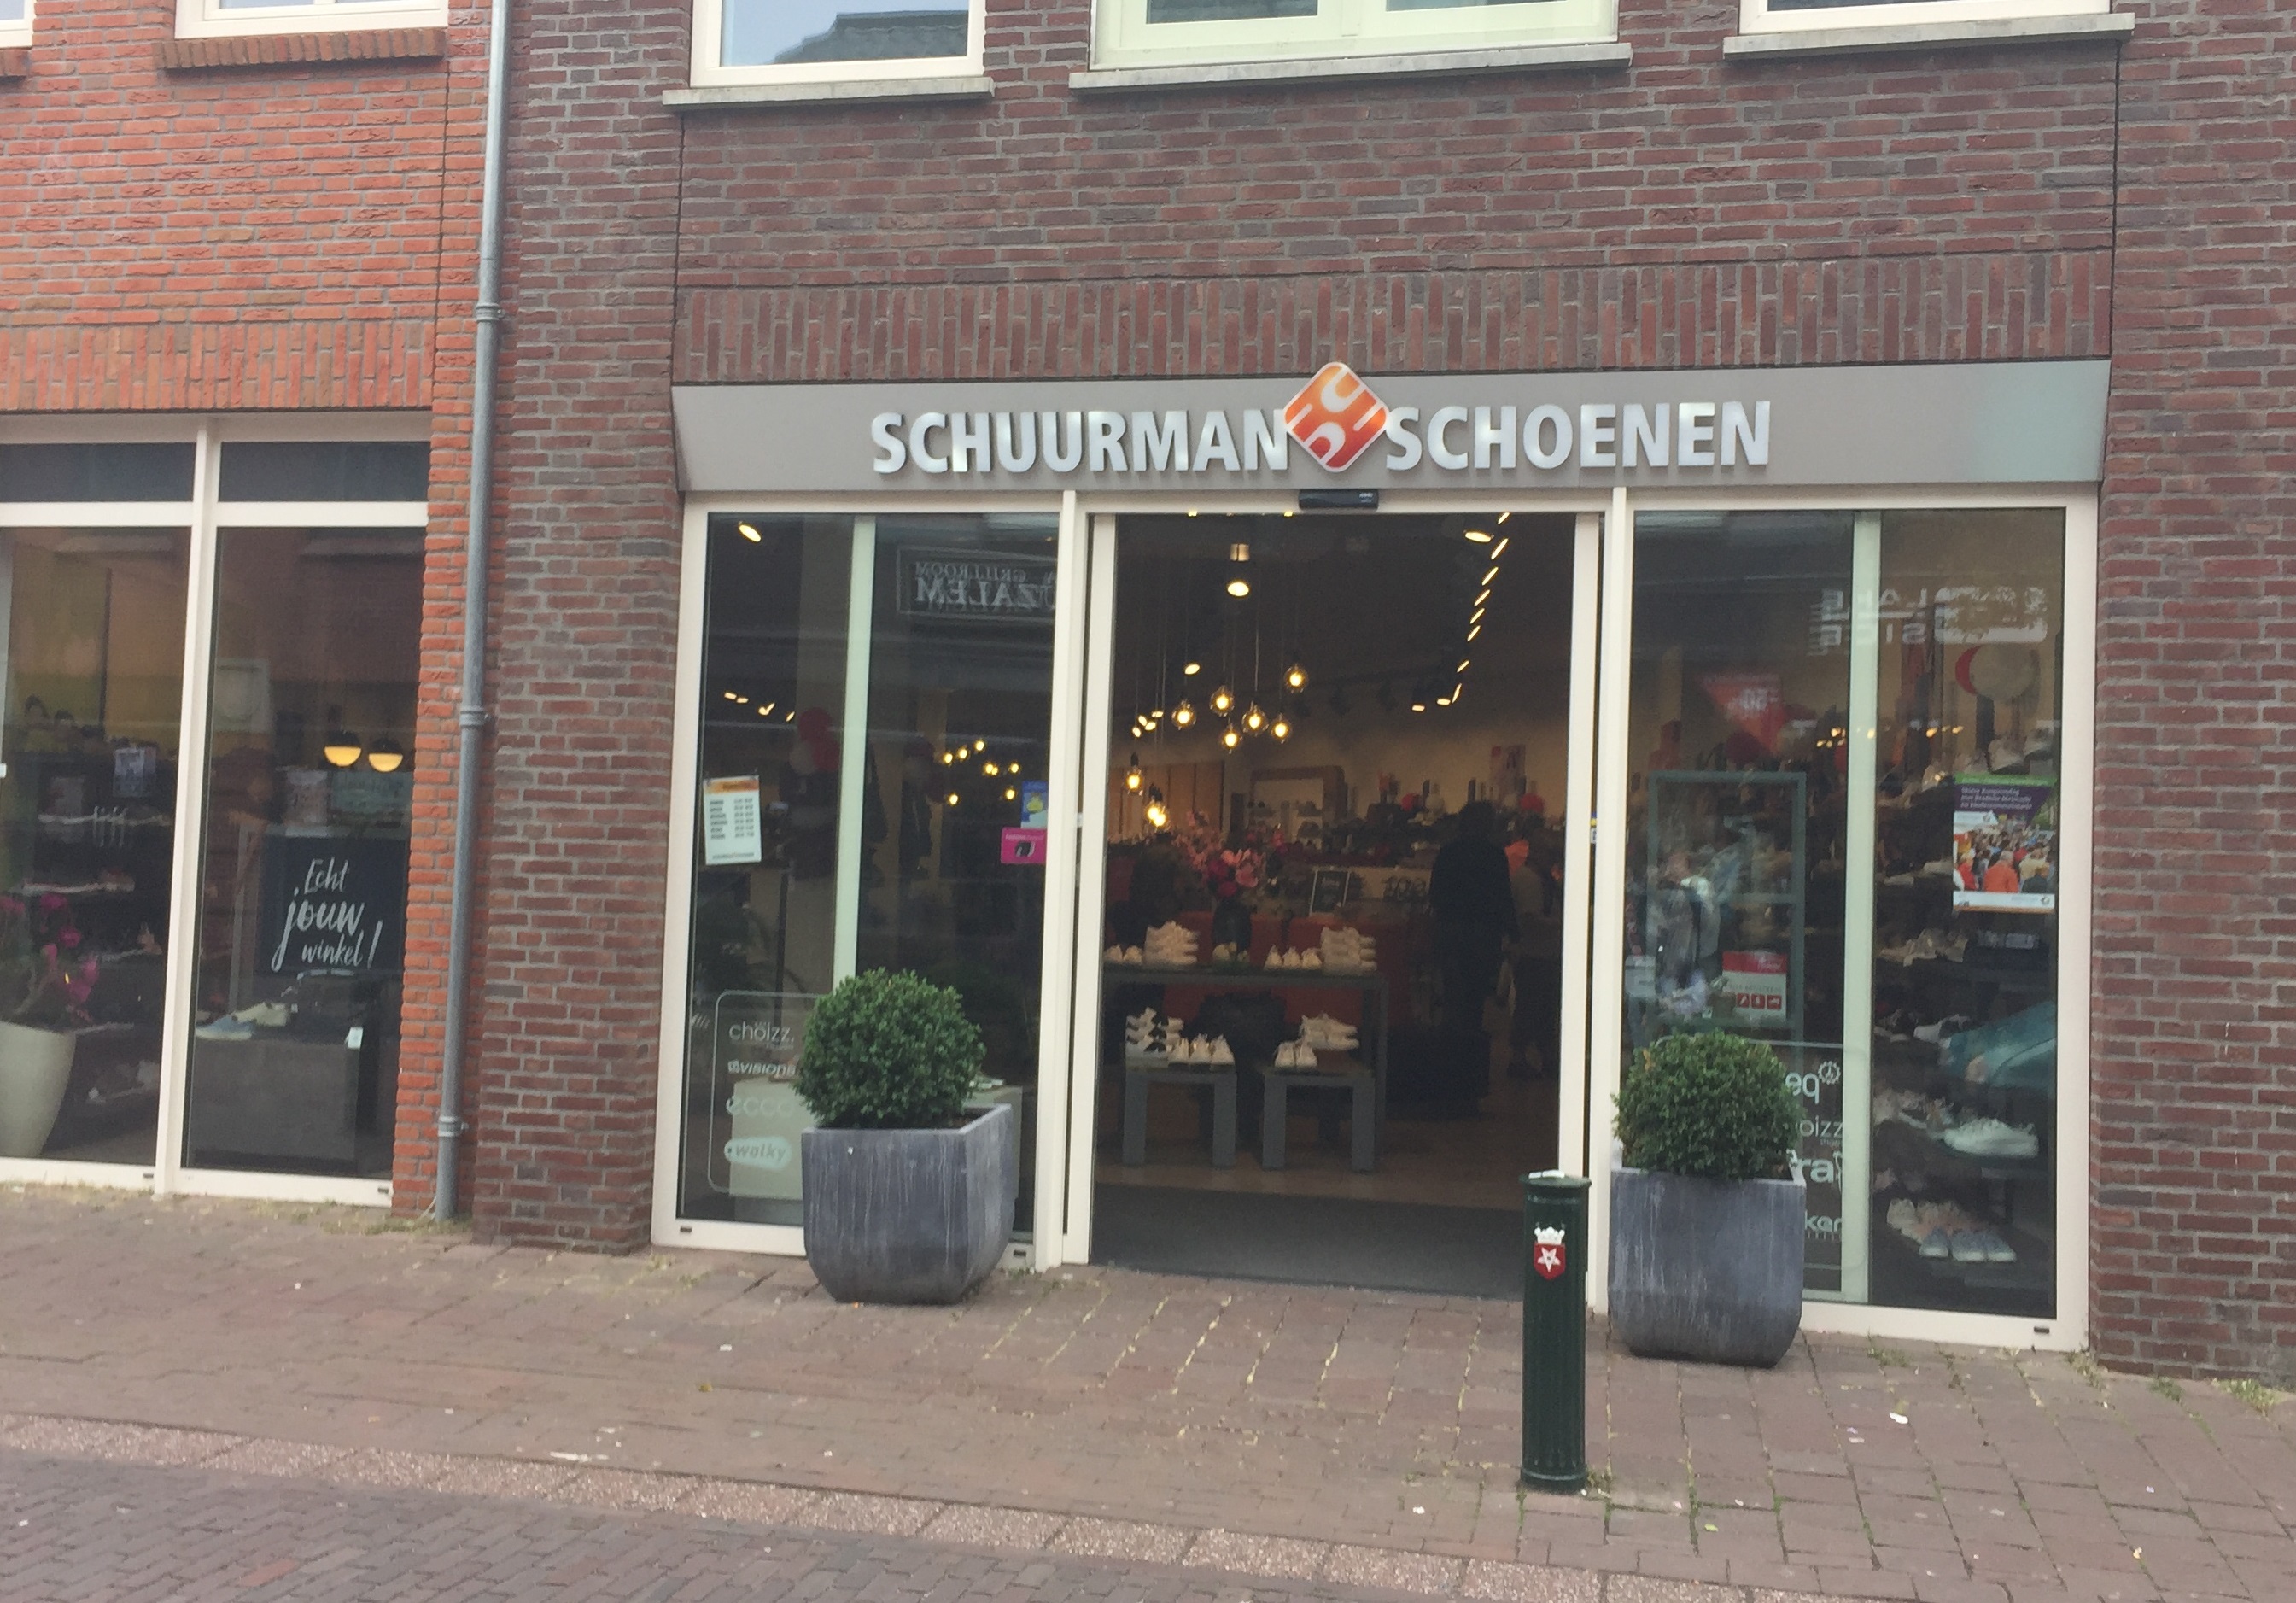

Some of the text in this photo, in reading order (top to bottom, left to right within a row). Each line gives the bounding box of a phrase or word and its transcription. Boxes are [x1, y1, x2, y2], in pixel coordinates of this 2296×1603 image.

[871, 401, 1771, 474] SCHUURMAN SCHOENEN
[304, 857, 349, 894] Echt
[271, 886, 365, 973] jouw
